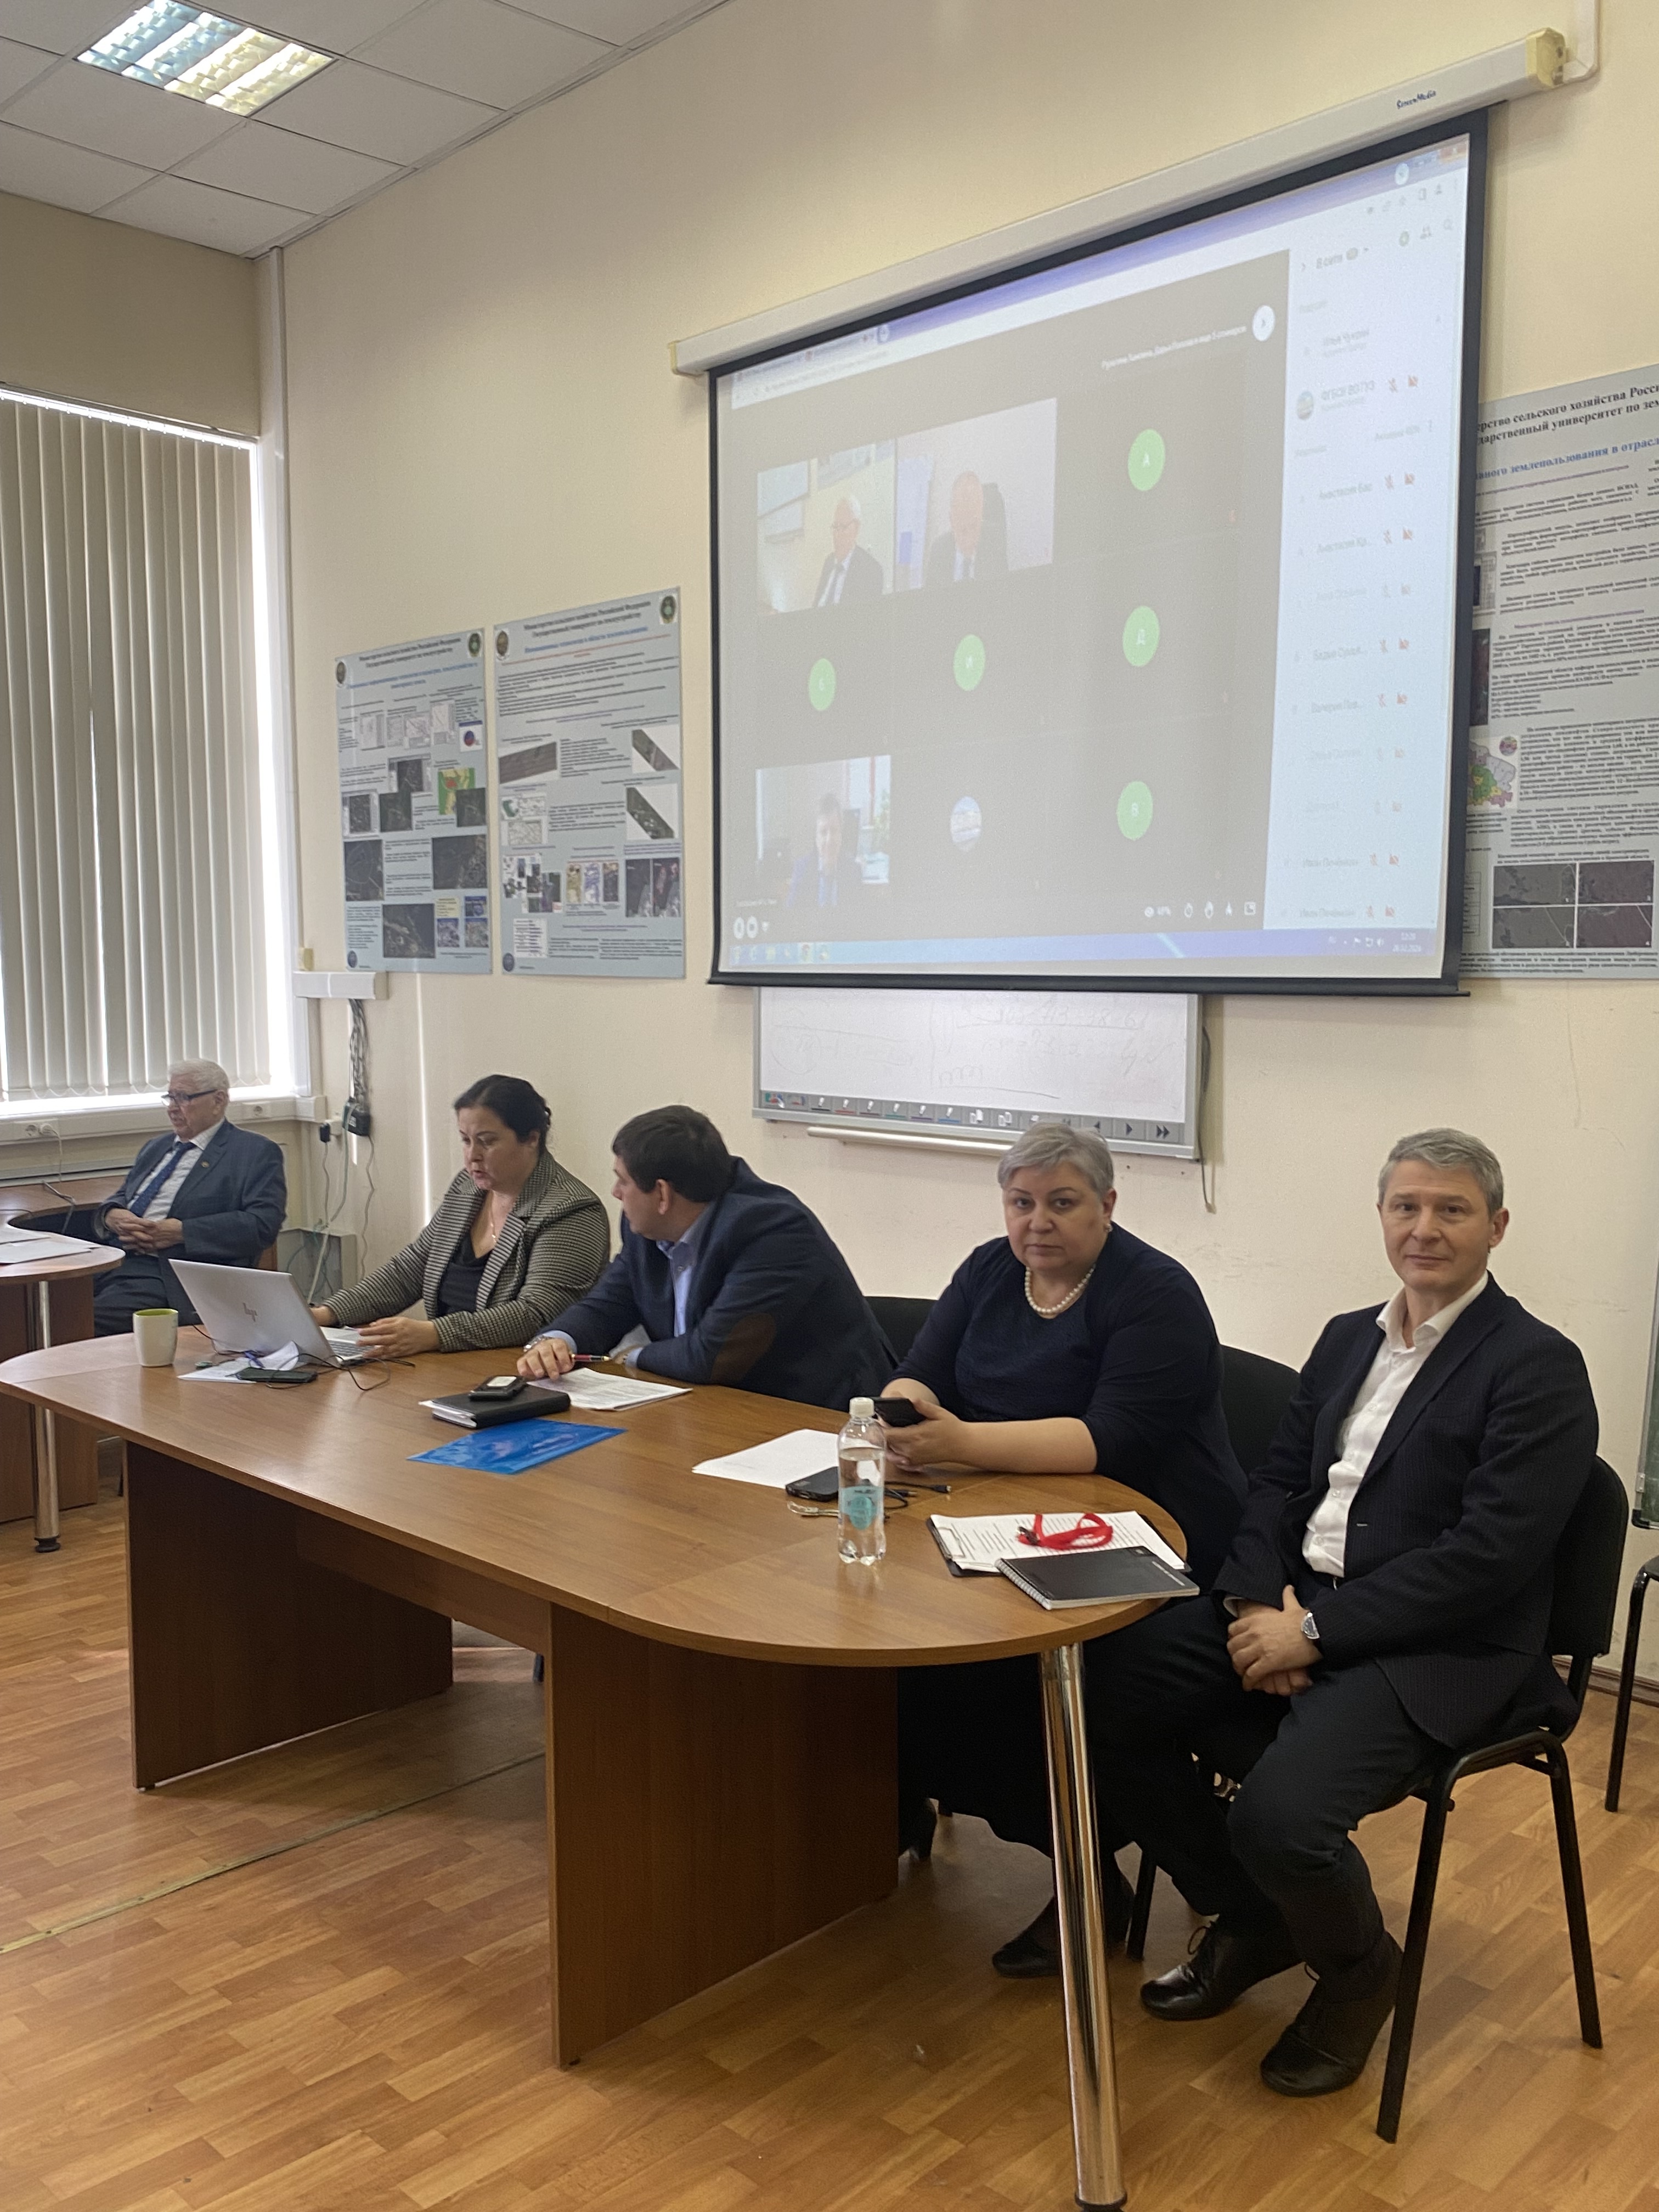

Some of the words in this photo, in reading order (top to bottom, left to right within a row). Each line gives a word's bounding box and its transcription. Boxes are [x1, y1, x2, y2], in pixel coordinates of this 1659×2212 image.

[1513, 405, 1567, 422] сельского
[1570, 391, 1626, 411] хозяйства
[1551, 407, 1622, 432] университет
[1626, 404, 1640, 413] по
[1511, 447, 1609, 473] землепользования
